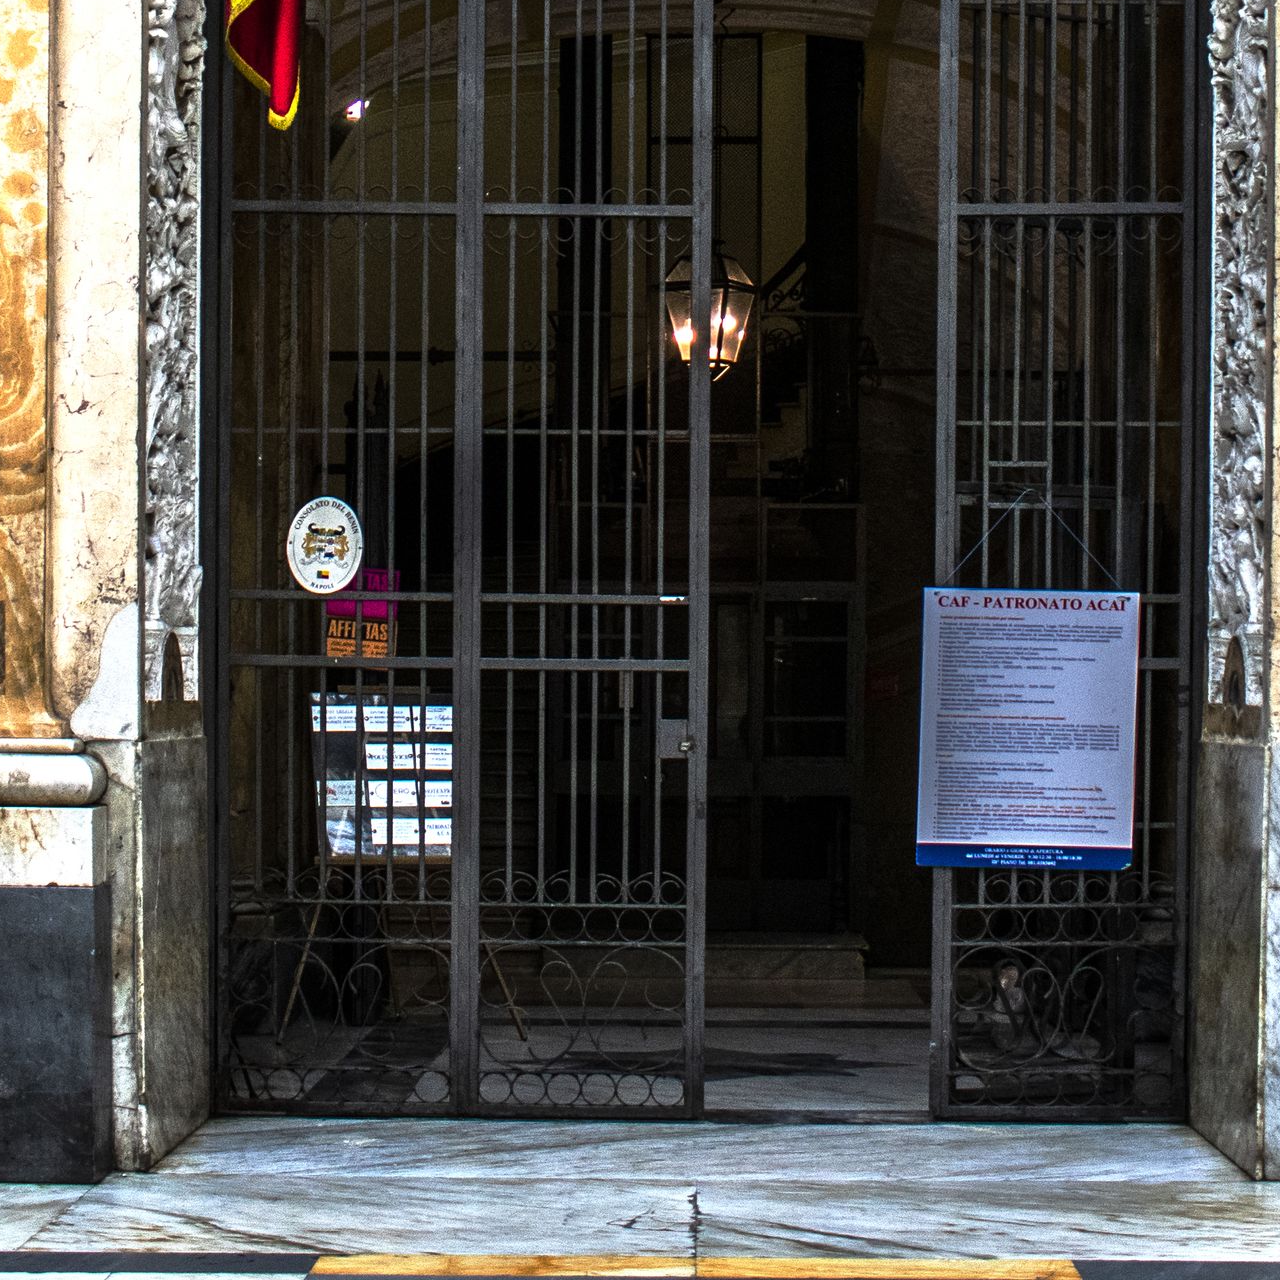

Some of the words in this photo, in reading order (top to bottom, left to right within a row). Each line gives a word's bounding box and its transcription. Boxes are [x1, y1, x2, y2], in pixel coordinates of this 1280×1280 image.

[294, 500, 330, 530] CONSOLATO
[331, 500, 346, 514] DEL
[345, 511, 359, 535] BENIN
[310, 582, 334, 590] NAPOLI
[938, 595, 970, 608] CAF
[983, 596, 1082, 610] PATRONATO
[1086, 598, 1126, 611] ACAI
